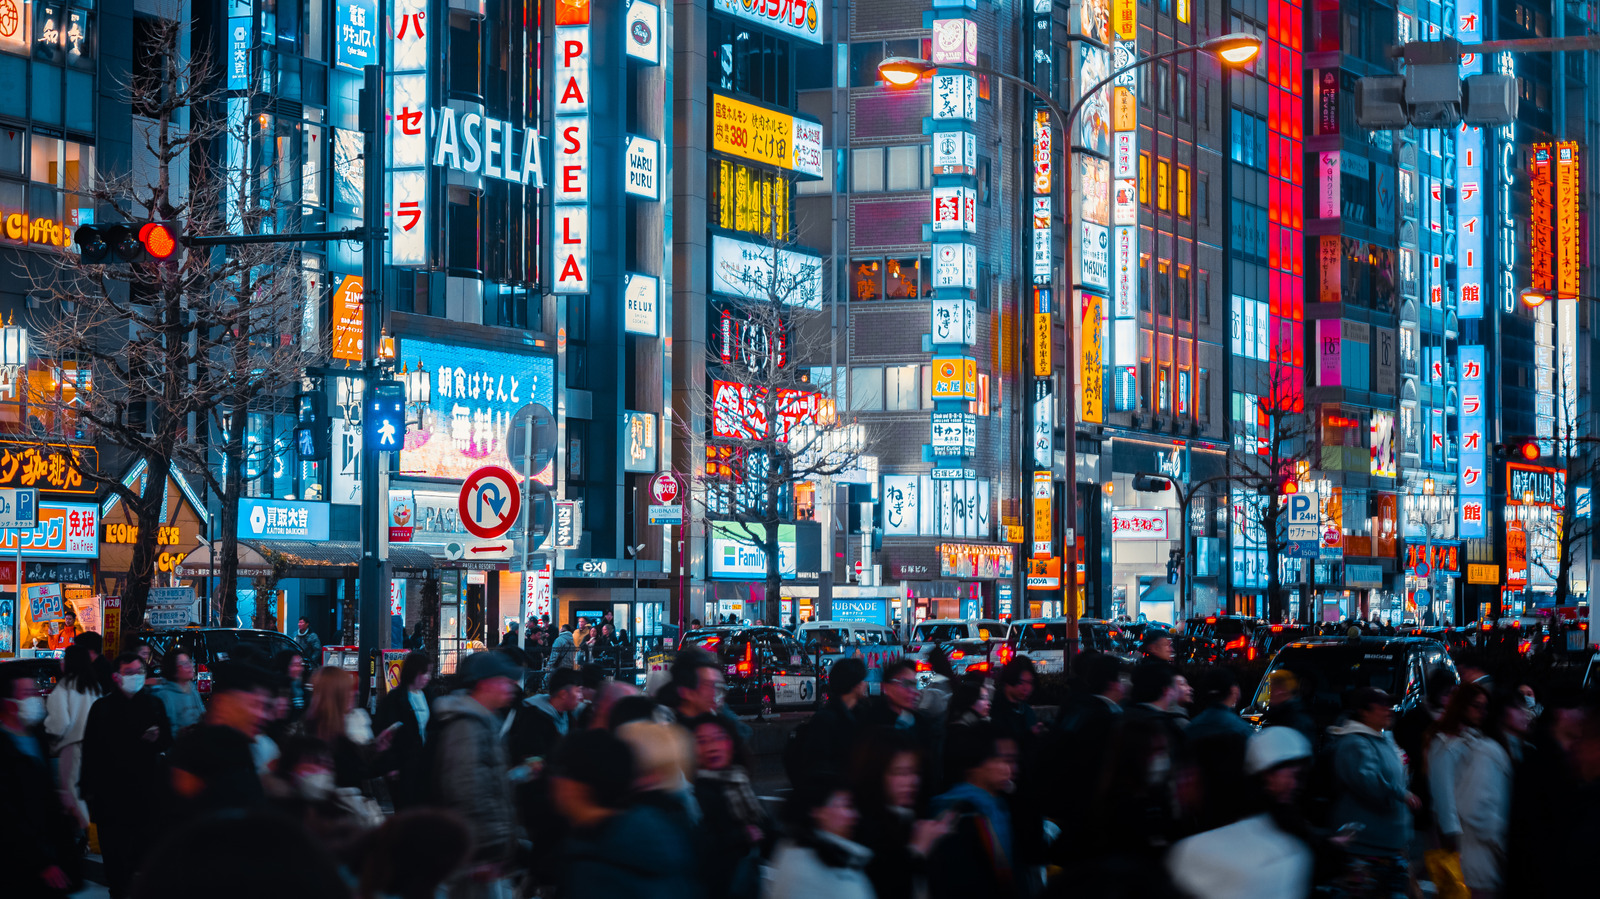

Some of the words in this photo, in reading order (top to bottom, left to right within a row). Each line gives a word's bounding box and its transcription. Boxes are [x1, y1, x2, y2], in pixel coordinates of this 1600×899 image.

[343, 24, 371, 48] サキュバス
[397, 11, 426, 232] パセラ
[730, 125, 748, 148] 380
[753, 130, 786, 159] たけ田
[559, 40, 585, 282] PASELA
[630, 153, 652, 172] WARU
[1120, 136, 1129, 174] カラオケ
[630, 173, 652, 189] PURU
[1561, 166, 1573, 289] コミック・インターネット
[1083, 258, 1107, 278] MASUYA
[624, 274, 629, 284] 3
[942, 276, 953, 284] 3F
[1034, 275, 1051, 284] 4F
[628, 299, 653, 312] RELUX
[936, 307, 950, 339] ねぎし
[438, 365, 519, 402] 朝食はなんと
[936, 381, 961, 392] 松屋
[624, 413, 629, 423] 2
[934, 424, 961, 436] 牛かつ
[1463, 361, 1481, 521] カラオケ館
[906, 482, 916, 508] 牛たん
[1512, 470, 1552, 502] 快活CLUB
[21, 494, 30, 509] P
[887, 485, 904, 528] ねぎし
[1291, 495, 1310, 520] P
[69, 509, 95, 537] 免税
[267, 506, 309, 528] 買取大吉
[558, 507, 571, 545] カラオケ
[1112, 517, 1163, 533] まねきねこ
[1300, 512, 1316, 520] 24H
[70, 539, 80, 551] Tax
[80, 540, 94, 551] Free
[462, 562, 478, 570] PASELA
[901, 565, 928, 573] 石塚ビル
[33, 595, 60, 615] ダイコク
